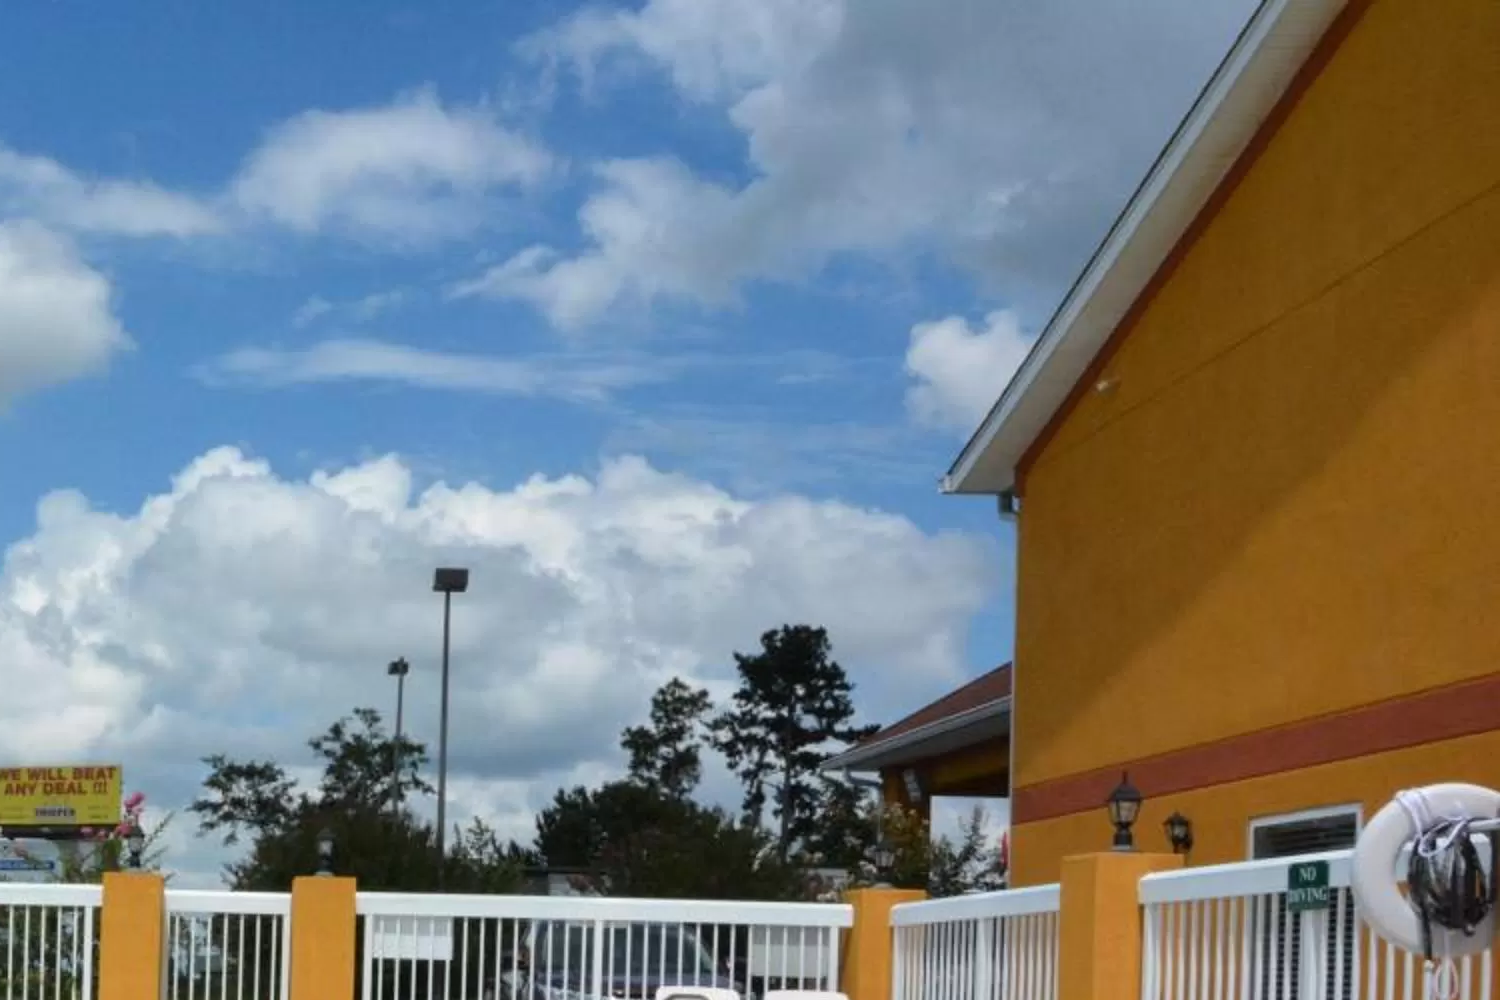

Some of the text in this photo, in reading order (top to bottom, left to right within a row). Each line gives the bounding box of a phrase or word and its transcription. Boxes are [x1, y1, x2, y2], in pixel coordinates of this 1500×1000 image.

[27, 767, 68, 781] WILL
[4, 783, 36, 796] ANY
[1299, 866, 1317, 881] NO
[1288, 886, 1328, 903] DIVING
